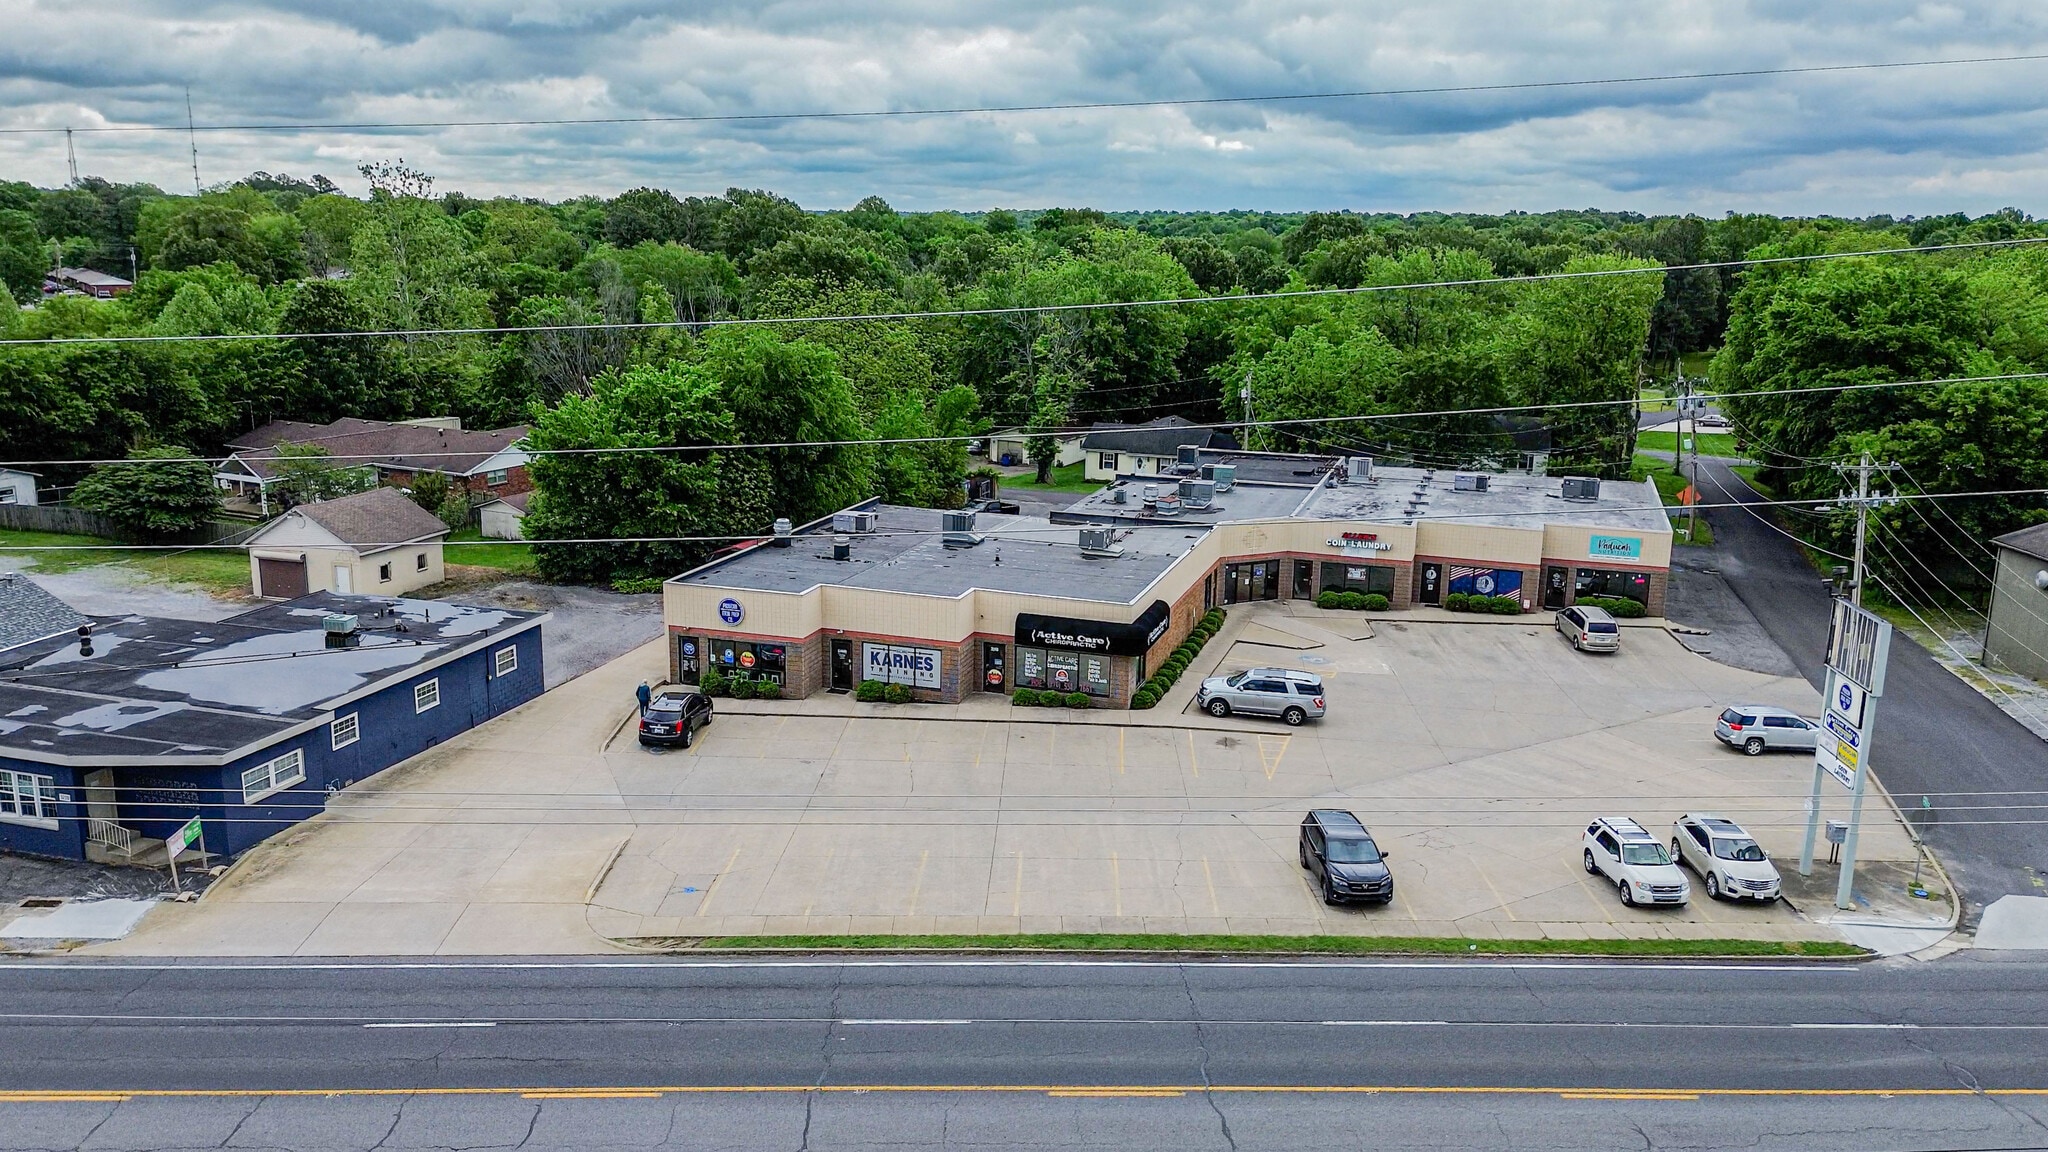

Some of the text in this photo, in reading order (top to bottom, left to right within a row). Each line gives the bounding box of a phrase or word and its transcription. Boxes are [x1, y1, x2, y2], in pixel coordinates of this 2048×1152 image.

[1326, 539, 1392, 550] COIN LAUNDRY
[1036, 631, 1105, 644] Active Care
[1045, 639, 1097, 648] CHIROPRACTIC
[870, 651, 934, 671] KARNES
